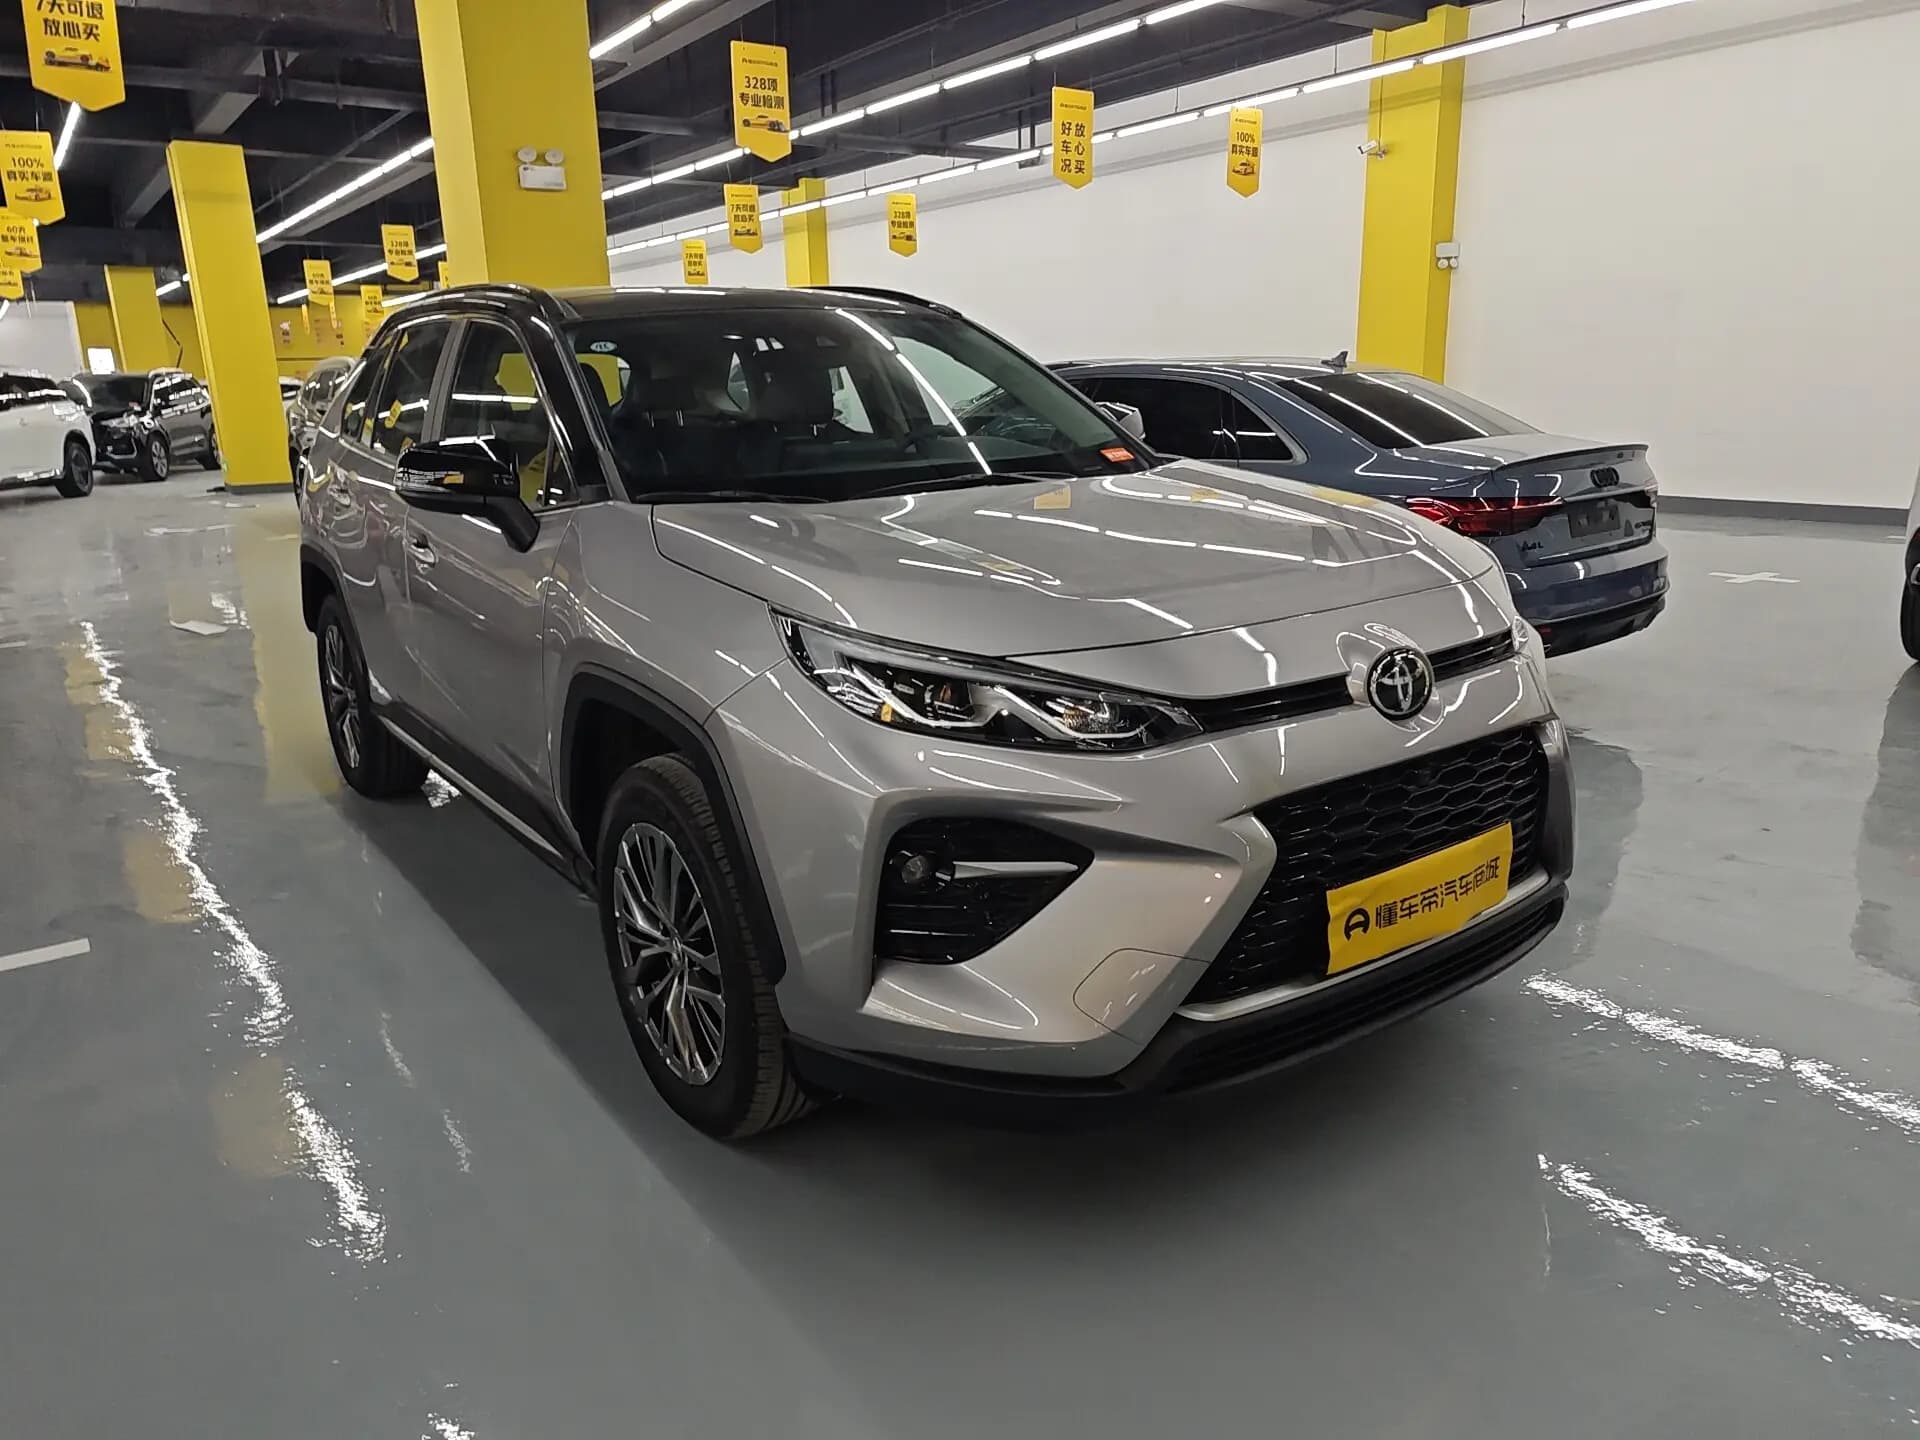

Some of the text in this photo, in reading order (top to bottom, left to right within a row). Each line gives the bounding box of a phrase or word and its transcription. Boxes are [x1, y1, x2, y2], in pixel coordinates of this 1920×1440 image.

[43, 18, 100, 41] 放心买
[744, 75, 778, 92] 328项
[739, 92, 785, 110] 专业检测
[1060, 121, 1073, 174] 好车况
[1236, 131, 1256, 144] 100%
[1074, 122, 1086, 175] 放心买
[11, 157, 44, 168] 100%
[1375, 855, 1500, 930] 懂车帝汽车商城
